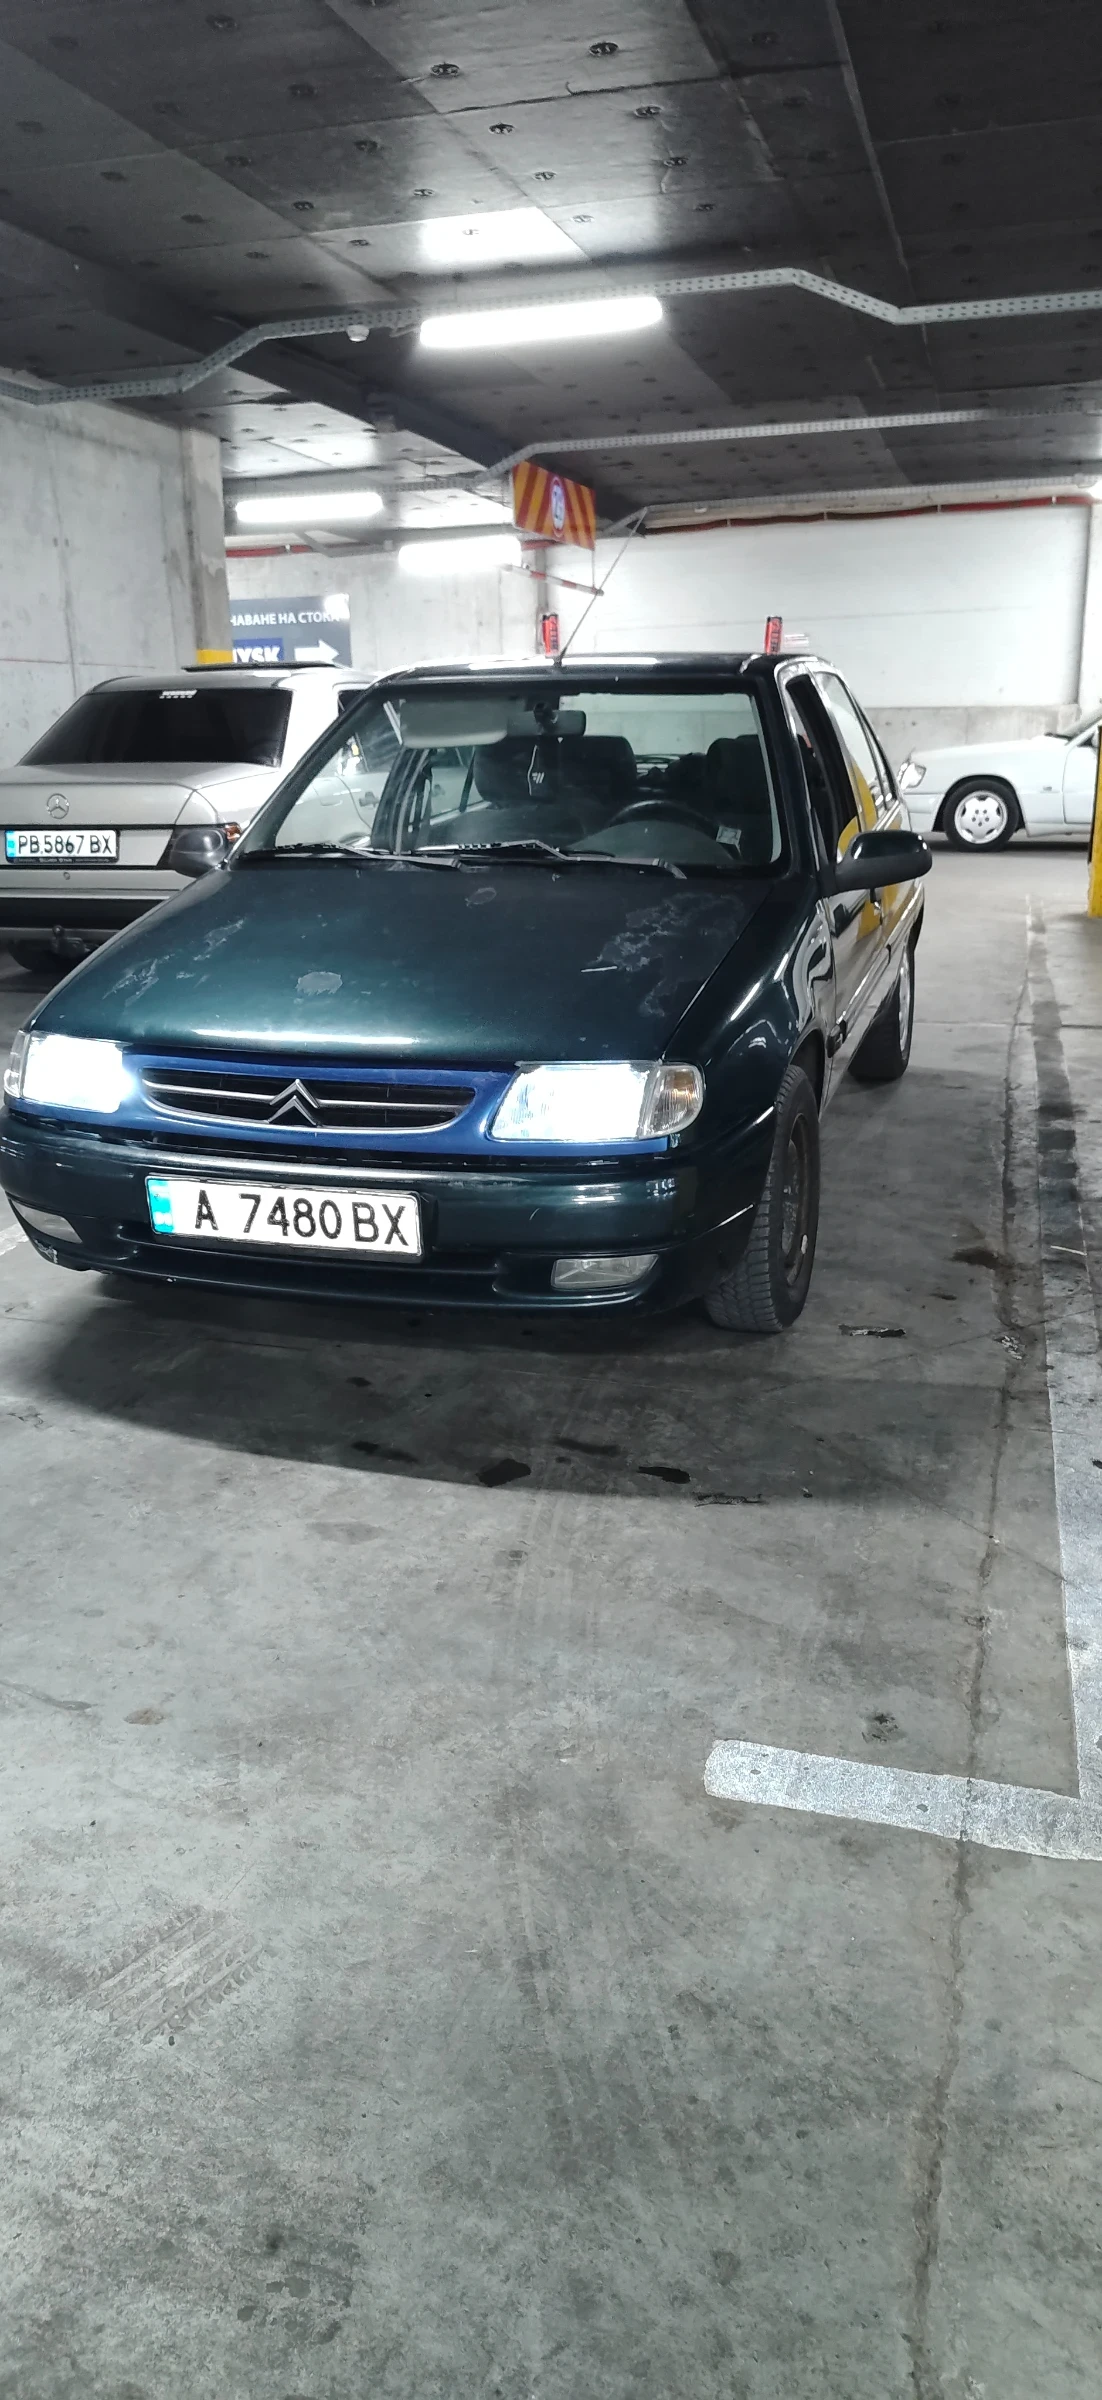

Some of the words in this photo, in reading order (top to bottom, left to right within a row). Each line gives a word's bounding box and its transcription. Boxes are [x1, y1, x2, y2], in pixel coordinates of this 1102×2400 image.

[278, 612, 297, 624] НА
[90, 835, 112, 854] BX
[194, 1189, 218, 1231] A
[238, 1193, 342, 1239] 7480
[352, 1201, 409, 1246] BX
